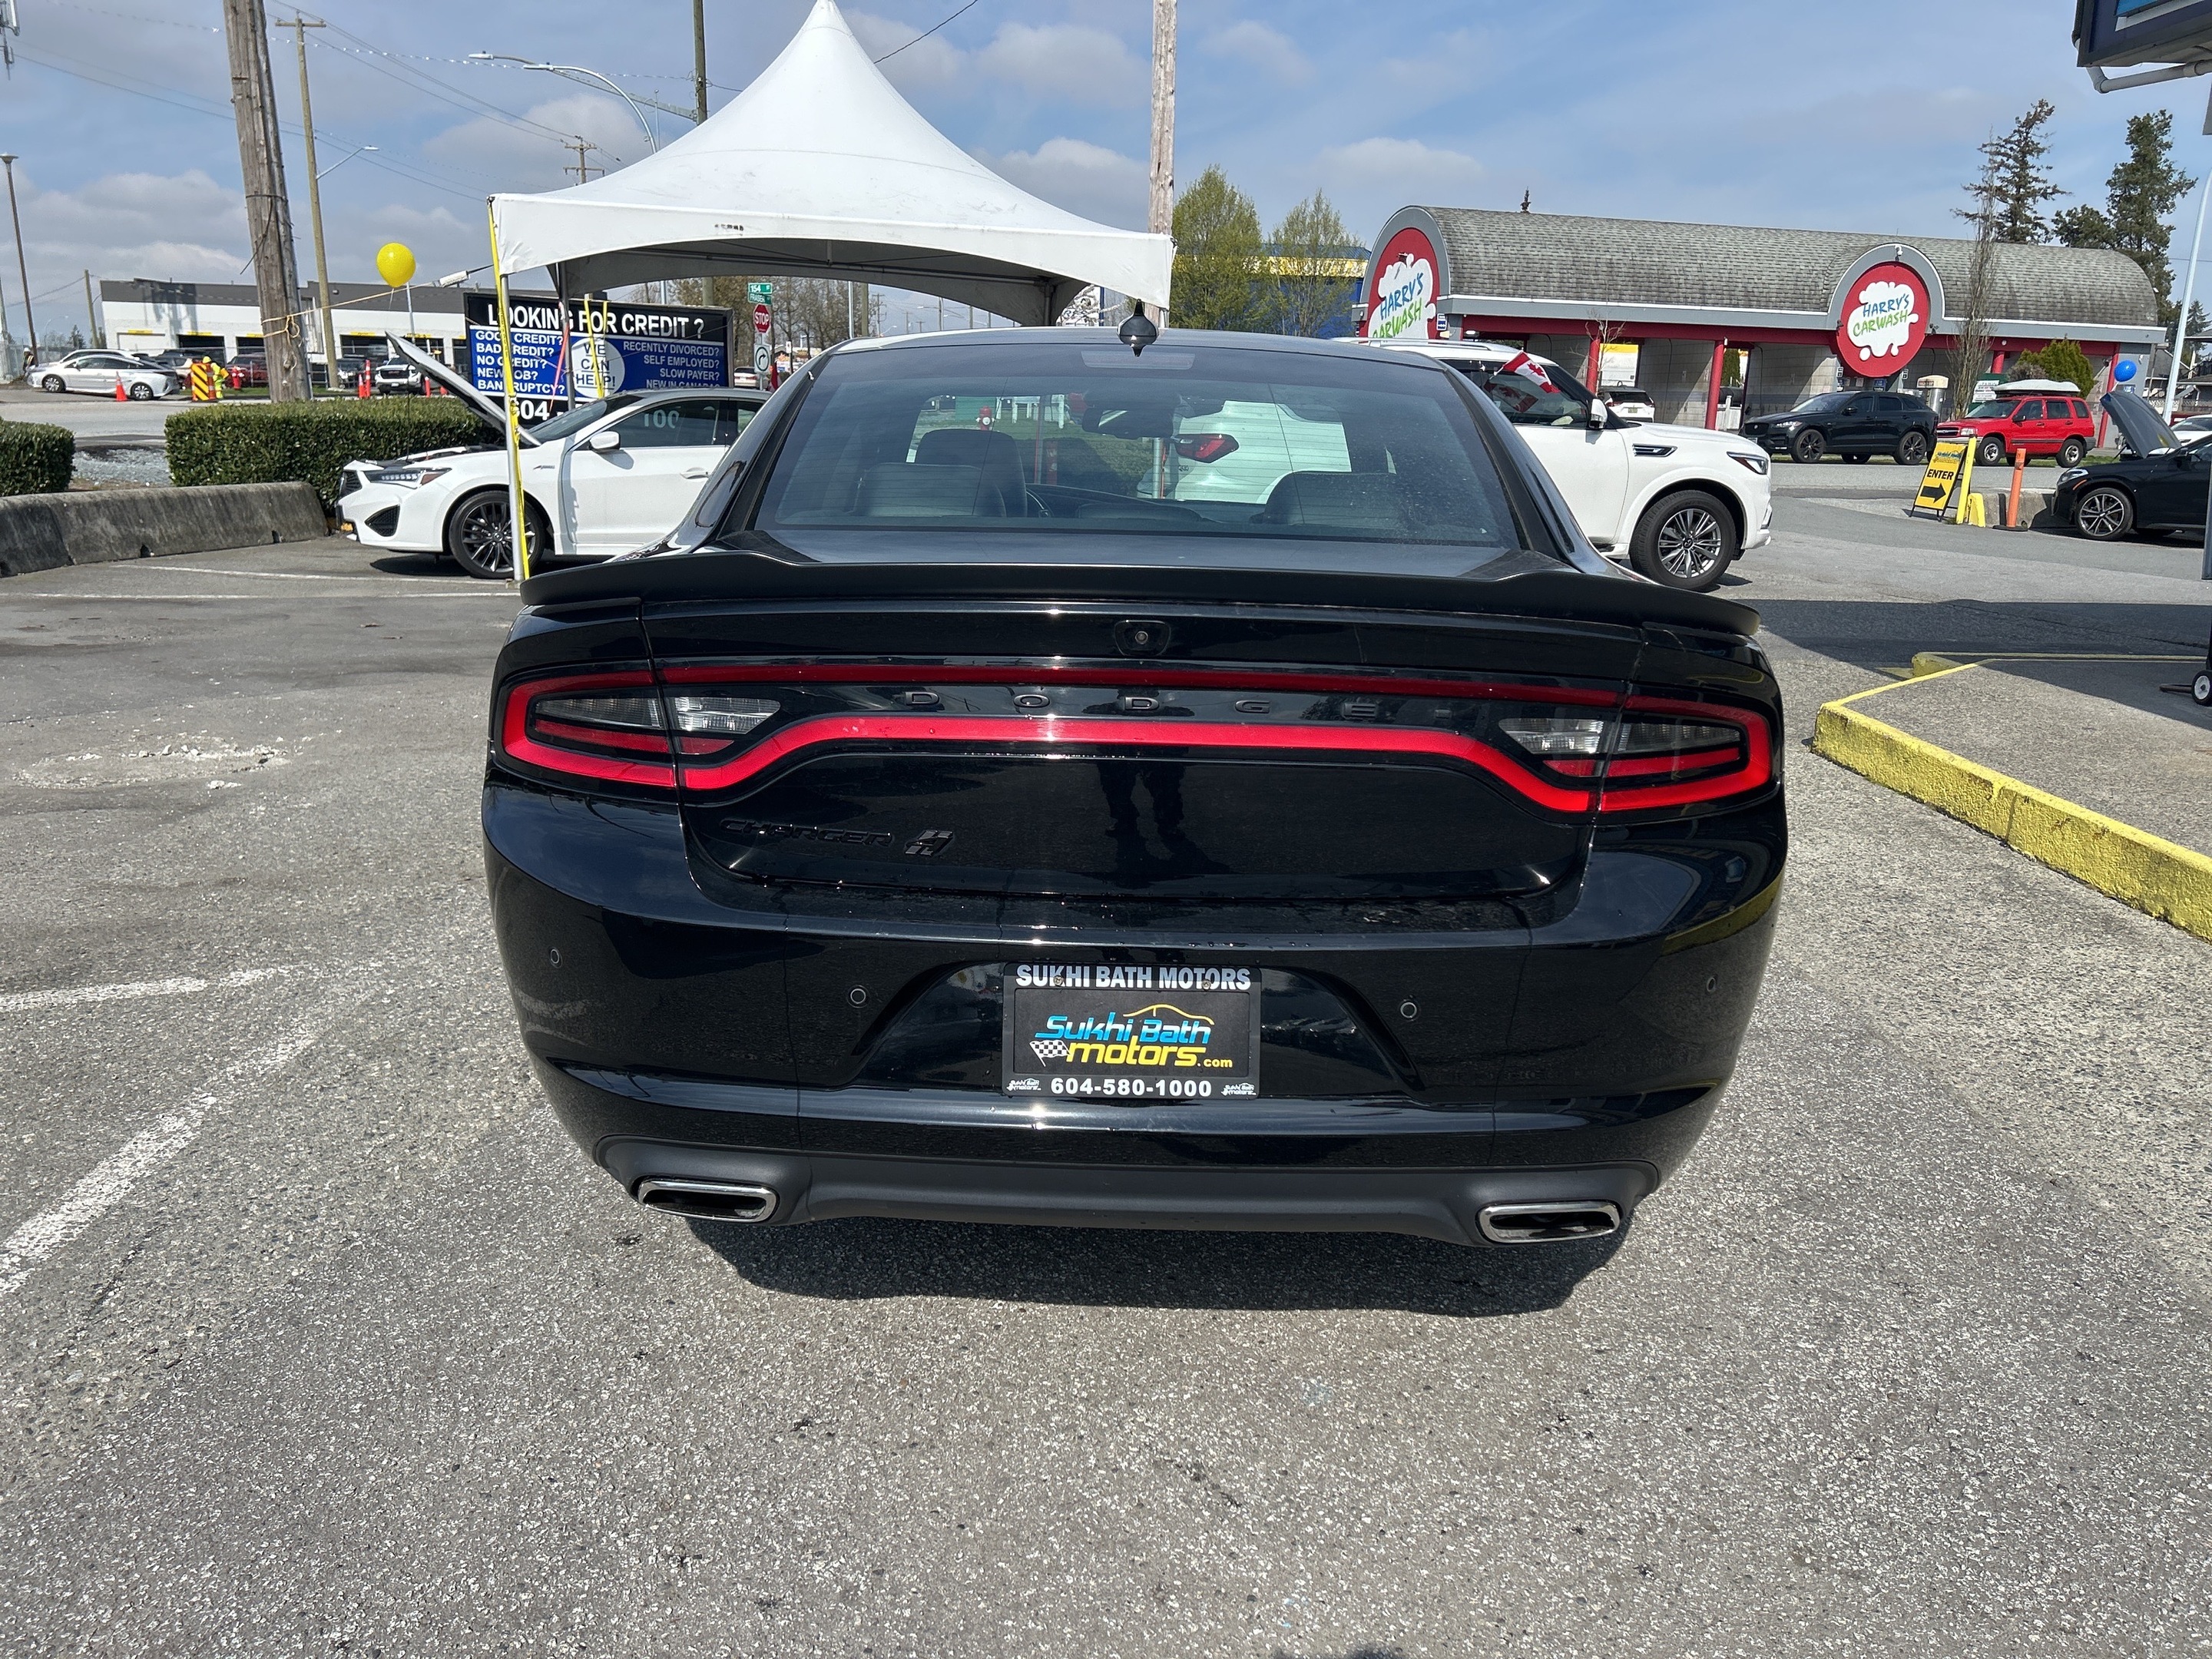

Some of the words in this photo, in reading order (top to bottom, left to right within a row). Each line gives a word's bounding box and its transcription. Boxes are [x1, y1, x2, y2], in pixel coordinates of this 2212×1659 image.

[750, 284, 761, 293] 154
[1380, 272, 1424, 320] HARRY'S
[1863, 293, 1909, 317] HARRY'S
[578, 310, 618, 333] FOR
[621, 313, 690, 339] CREDIT
[755, 311, 769, 326] STOP
[1853, 310, 1909, 336] CARWASH
[475, 330, 502, 342] GOO
[514, 333, 564, 346] CREDIT?
[476, 343, 502, 353] BAD
[512, 345, 555, 357] REDIT?
[623, 340, 669, 353] RECENTLY
[670, 343, 720, 357] DIVORCED?
[476, 355, 495, 366] NO
[497, 356, 548, 369] CEDIT?
[644, 354, 665, 365] SELF
[667, 356, 720, 369] EMPLOYED?
[514, 369, 538, 381] OB?
[660, 367, 686, 378] SLOW
[687, 369, 720, 381] PAYER?
[478, 379, 565, 394] BANRUPTCY?
[646, 379, 667, 389] NEW
[1926, 469, 1955, 481] ENTER
[905, 690, 1378, 720] DODGE
[720, 819, 894, 846] CHARGER
[1015, 964, 1090, 988] SUKHI
[1095, 965, 1152, 988] BATH
[1158, 967, 1251, 991] MOTORS
[1035, 1011, 1134, 1041] Sukhi
[1139, 1018, 1212, 1045] Bath
[1051, 1077, 1212, 1098] 604-580-1000
